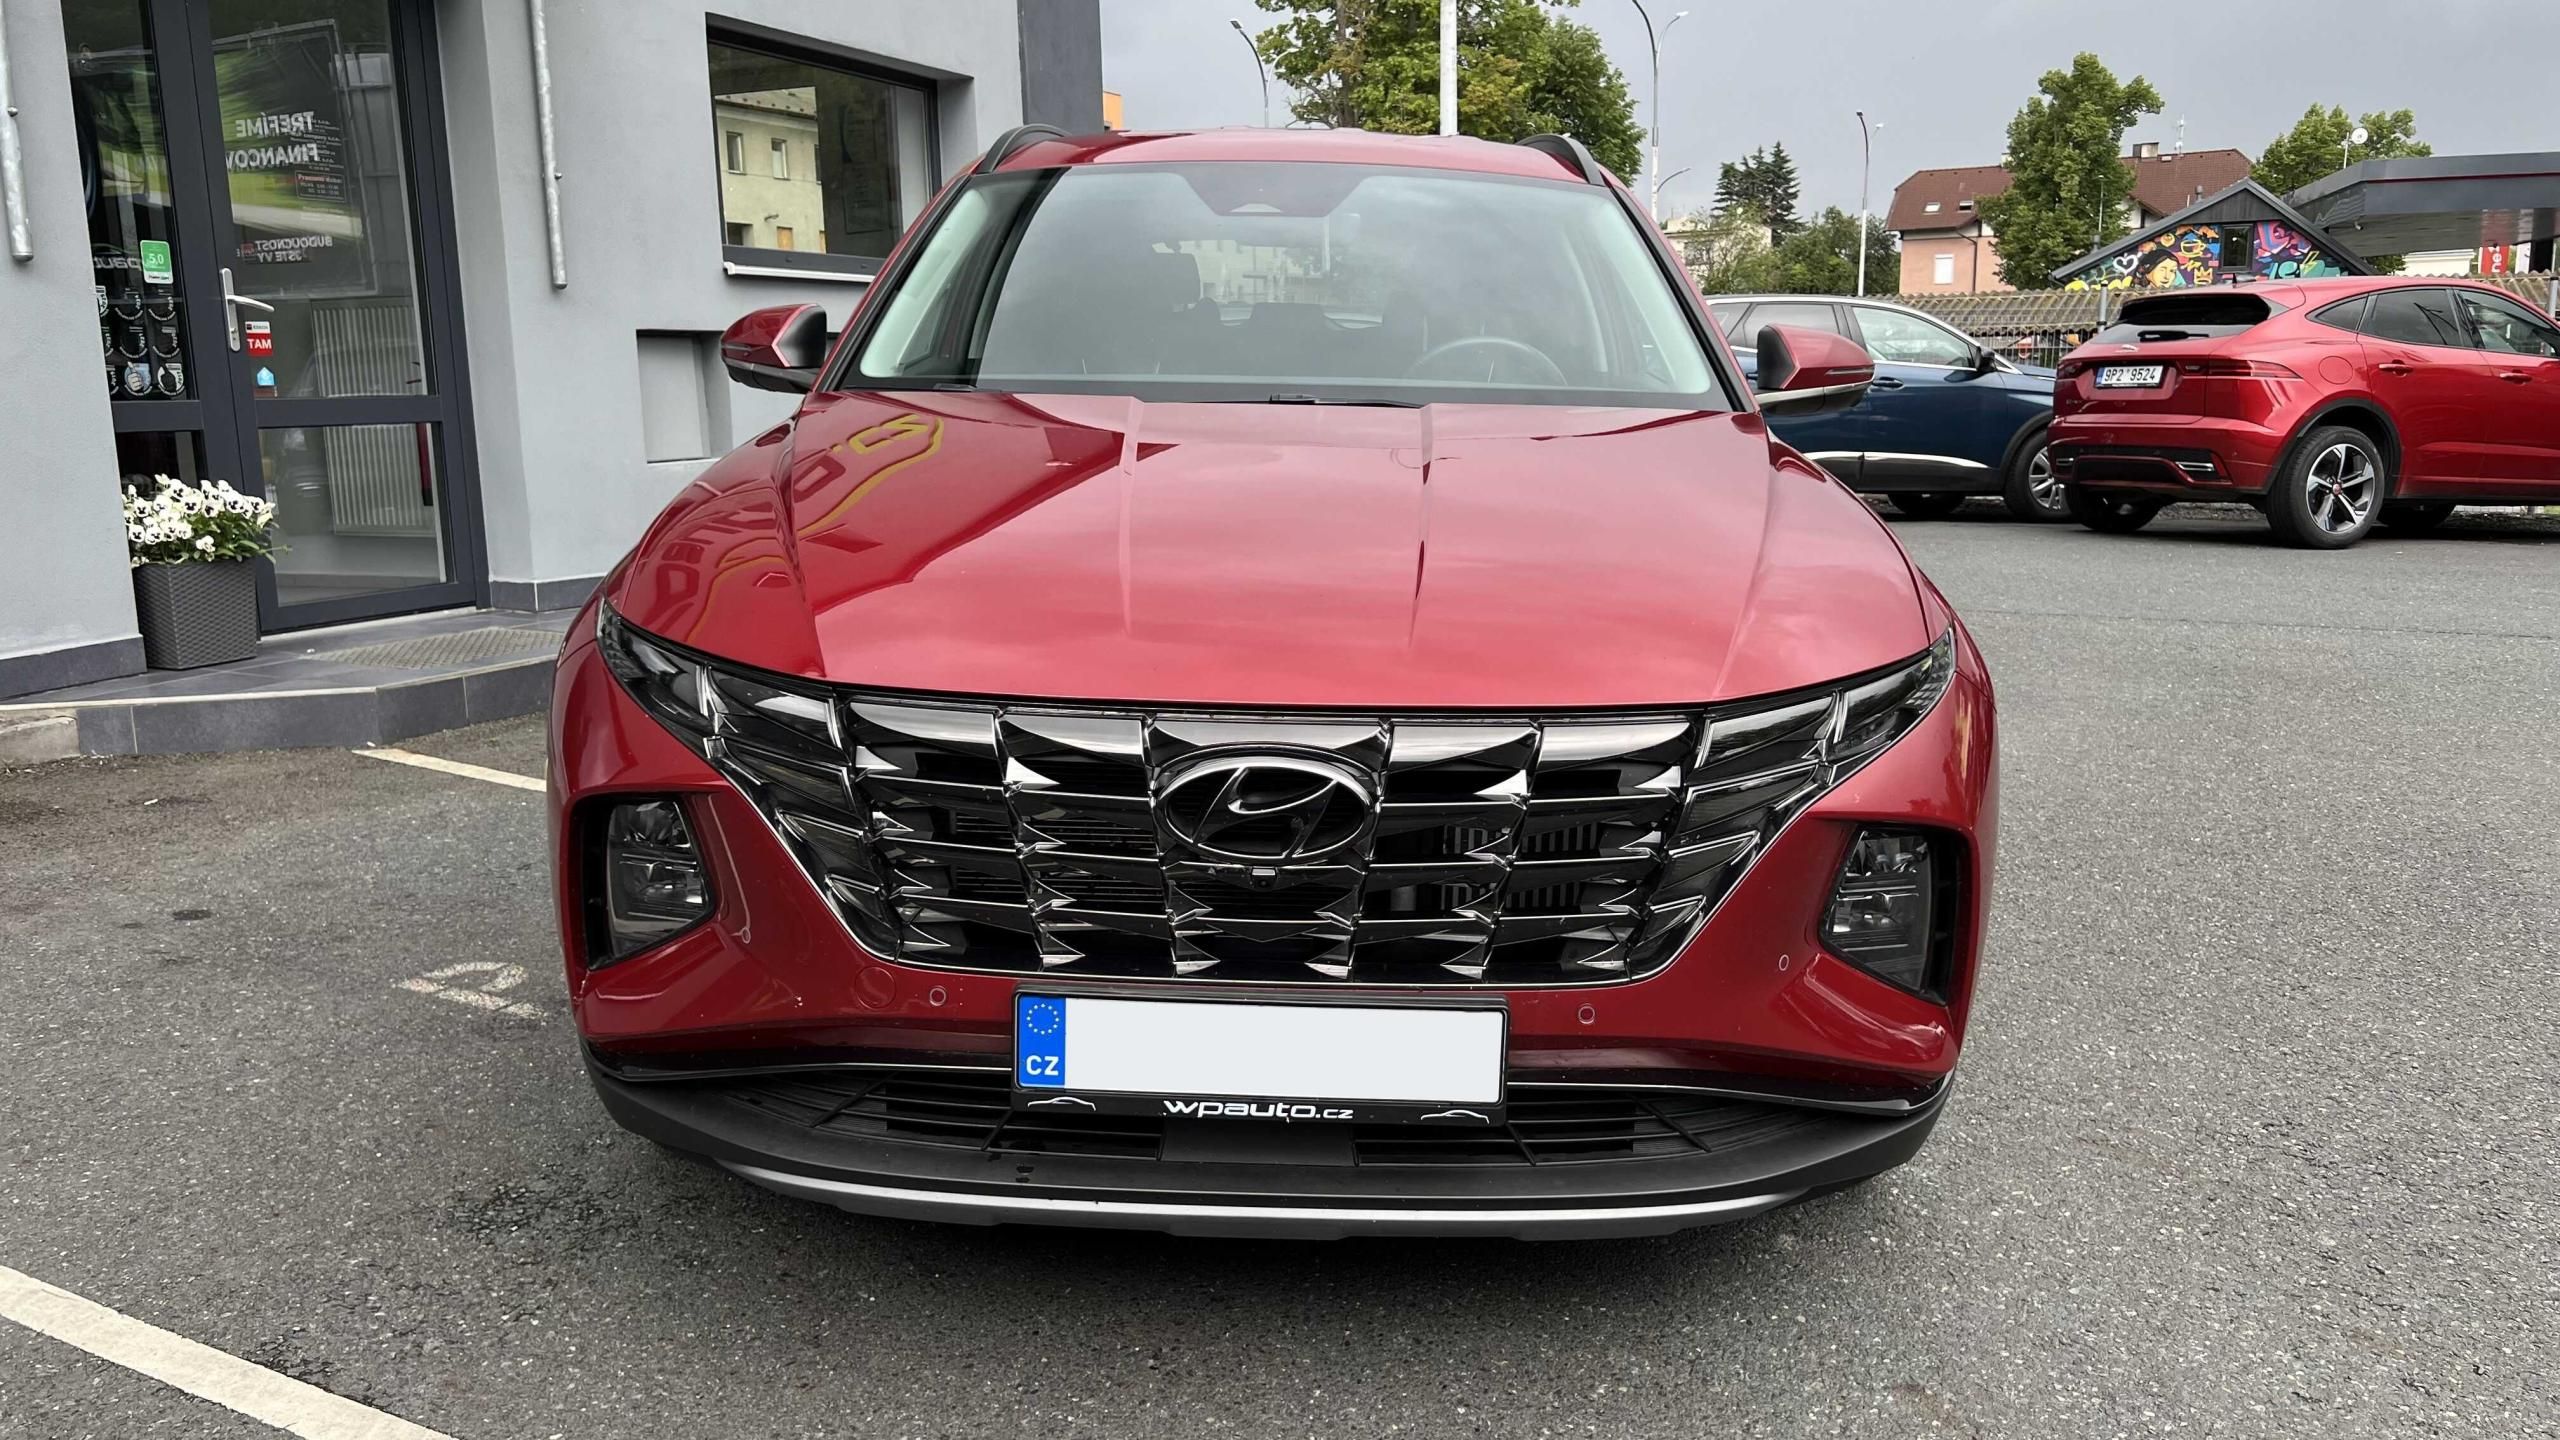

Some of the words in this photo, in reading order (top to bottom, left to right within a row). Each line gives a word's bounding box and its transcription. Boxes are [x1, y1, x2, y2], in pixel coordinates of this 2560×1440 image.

[246, 338, 272, 349] TAM
[2105, 368, 2124, 381] 9P2
[2130, 367, 2156, 381] 9524
[1026, 1055, 1059, 1076] CZ
[1163, 1100, 1354, 1118] wpauto.cz
